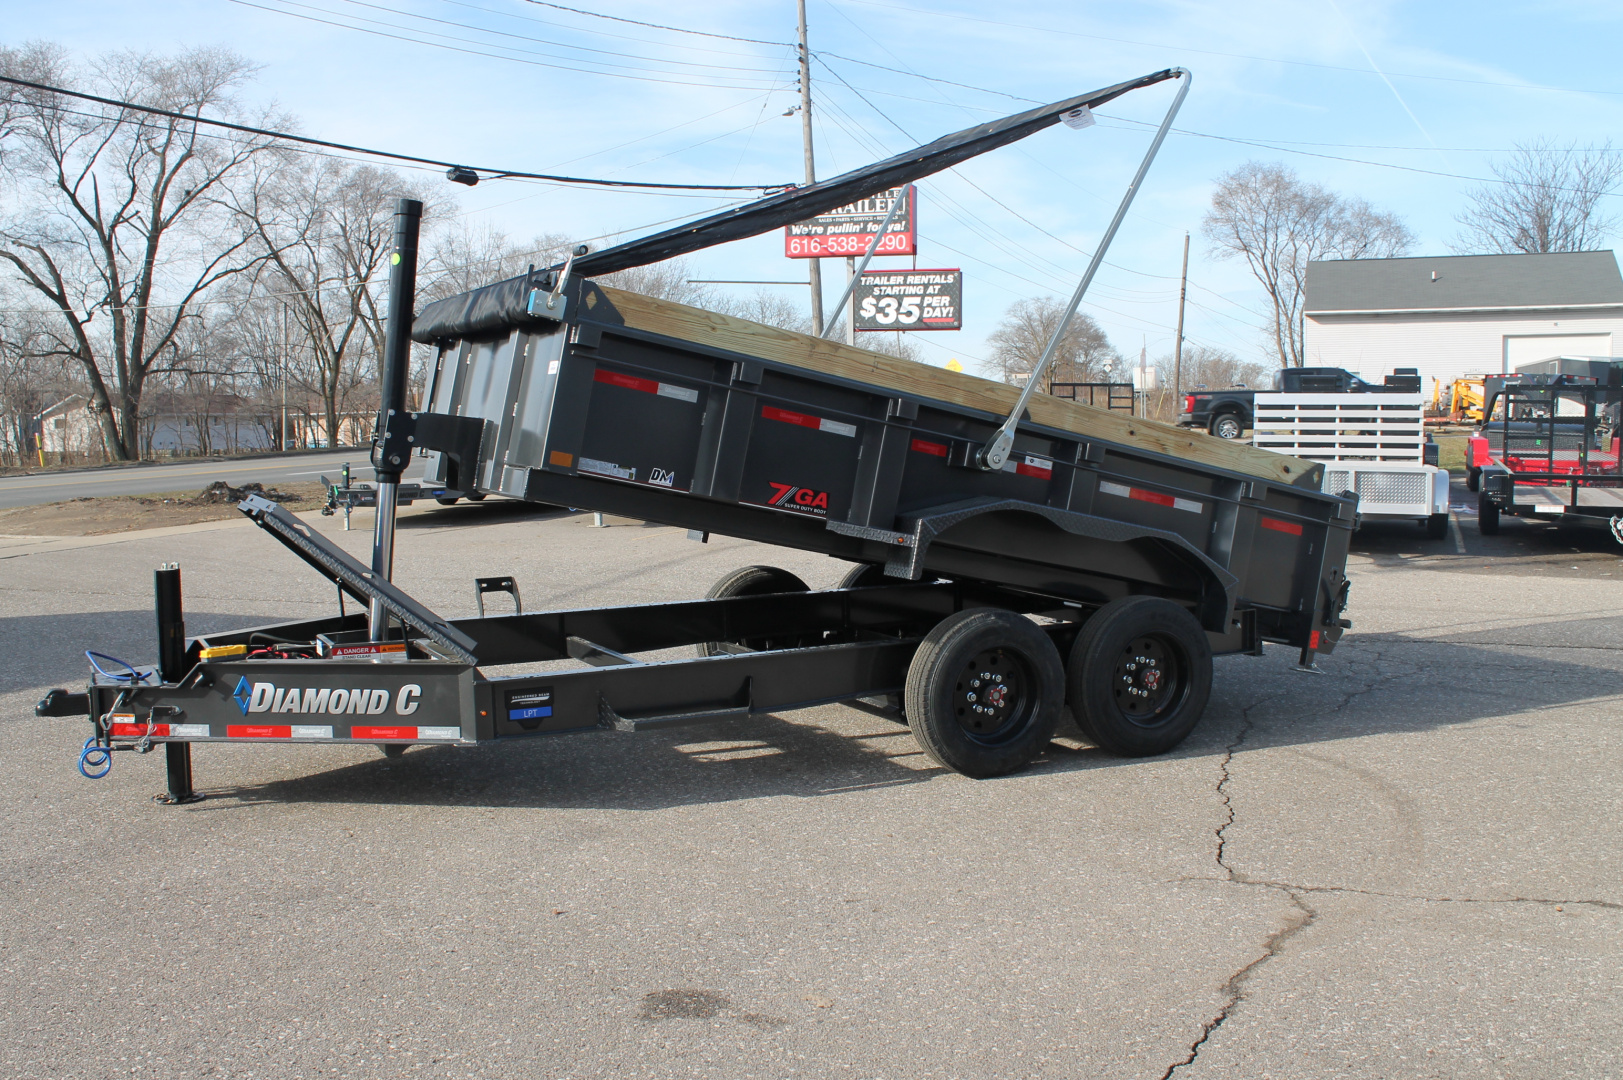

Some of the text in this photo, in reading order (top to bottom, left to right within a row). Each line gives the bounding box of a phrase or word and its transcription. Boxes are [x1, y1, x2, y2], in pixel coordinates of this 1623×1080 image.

[824, 199, 897, 215] AILE
[791, 224, 824, 235] We're
[826, 222, 863, 236] pullin'
[886, 220, 906, 233] ya!
[790, 234, 906, 254] 616-538-2290
[860, 274, 955, 286] TRAILER RENTALS
[872, 284, 942, 295] STARTING AT
[860, 295, 950, 325] $35 PER
[922, 306, 954, 318] DAY!
[651, 469, 673, 484] DM
[784, 502, 800, 510] SUPER
[343, 647, 369, 655] DANGER
[249, 682, 422, 716] DIAMOND C
[523, 709, 538, 718] LPT
